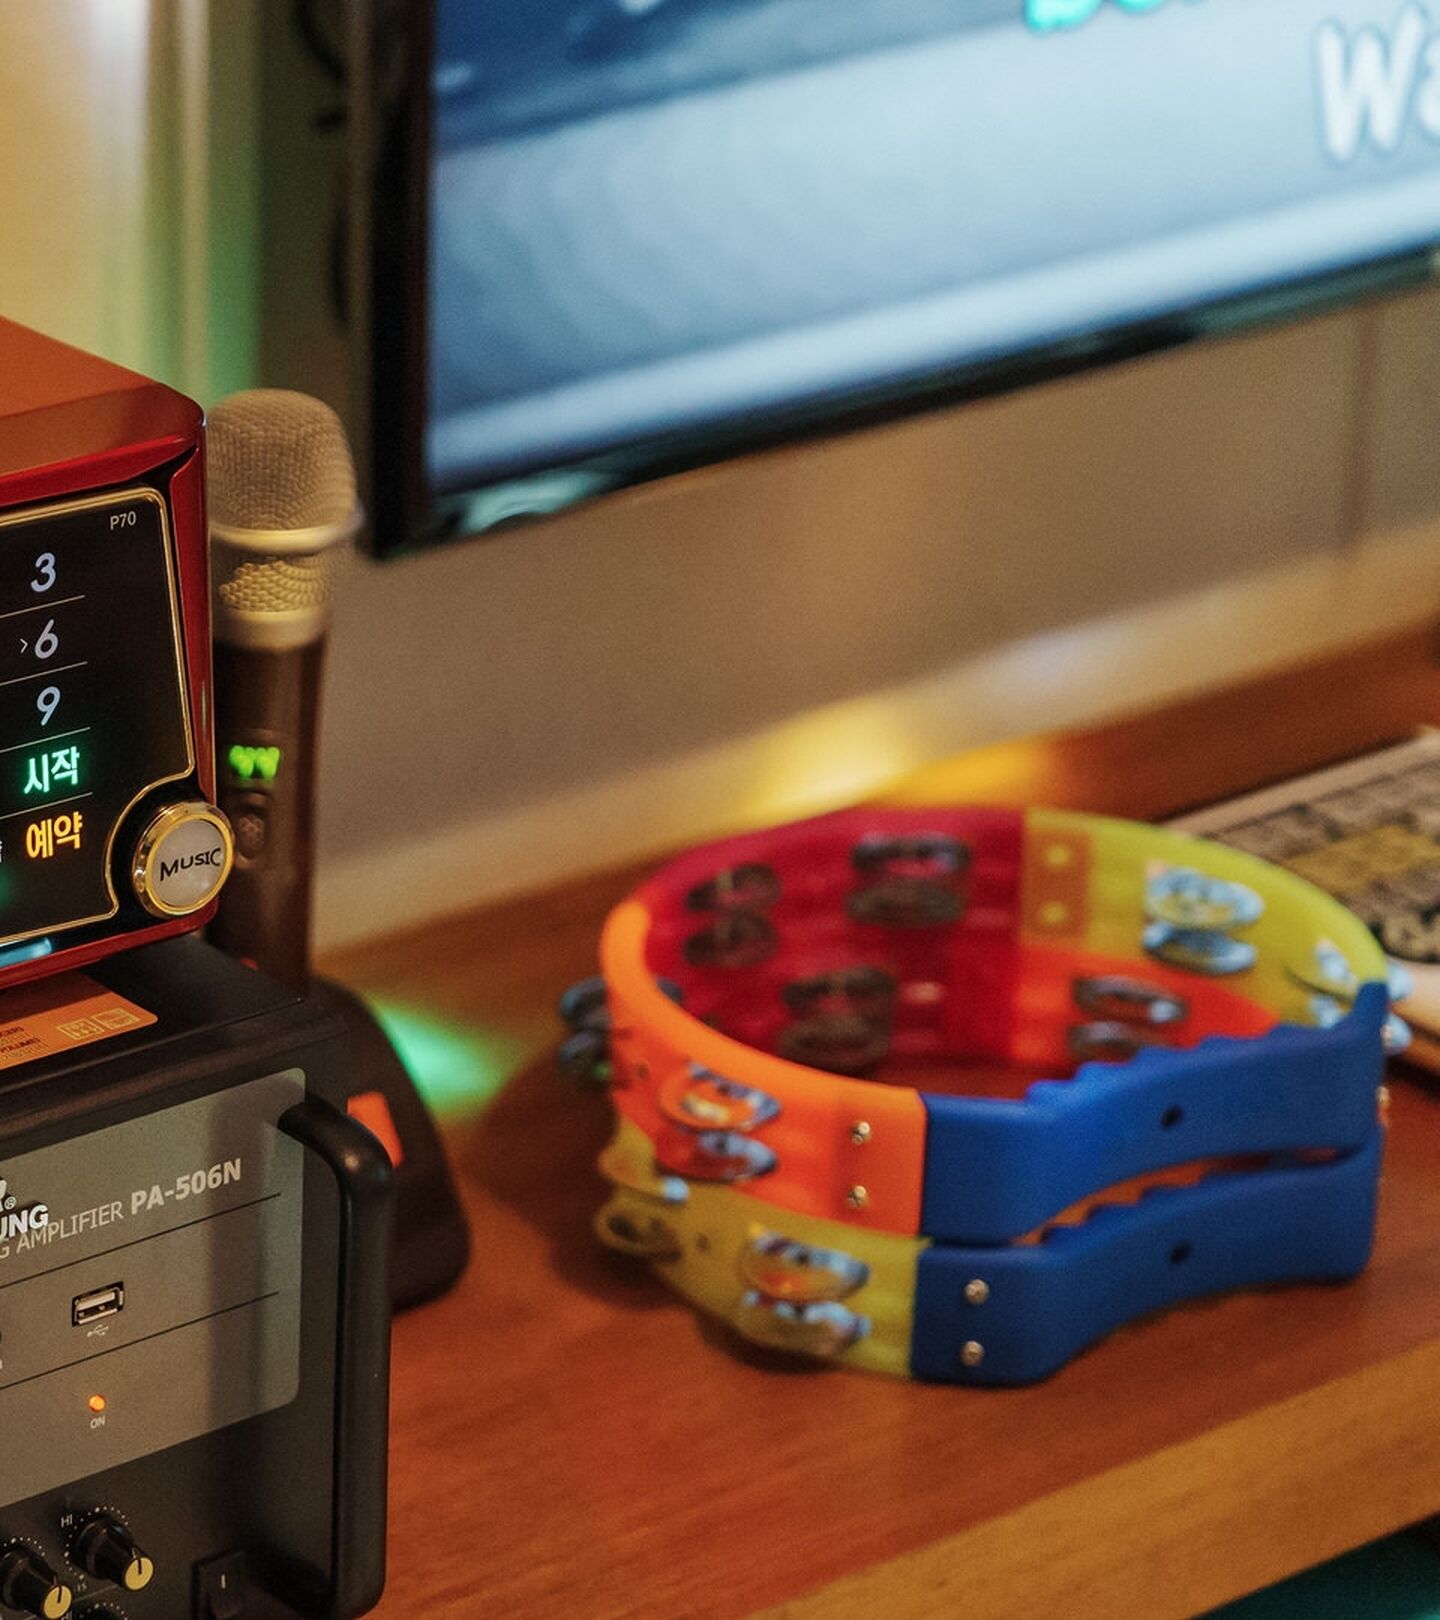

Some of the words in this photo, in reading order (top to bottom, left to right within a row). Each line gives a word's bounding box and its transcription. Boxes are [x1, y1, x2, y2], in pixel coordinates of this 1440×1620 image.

[110, 511, 137, 531] P70
[31, 552, 57, 592] 3
[34, 619, 59, 659] 6
[36, 686, 60, 726] 9
[23, 746, 81, 795] 시작
[25, 812, 83, 860] 예약
[160, 847, 221, 881] MUSIC
[16, 1202, 124, 1253] AMPLIFIER
[130, 1158, 242, 1215] PA-506N
[90, 1415, 106, 1430] ON
[61, 1514, 73, 1528] HI
